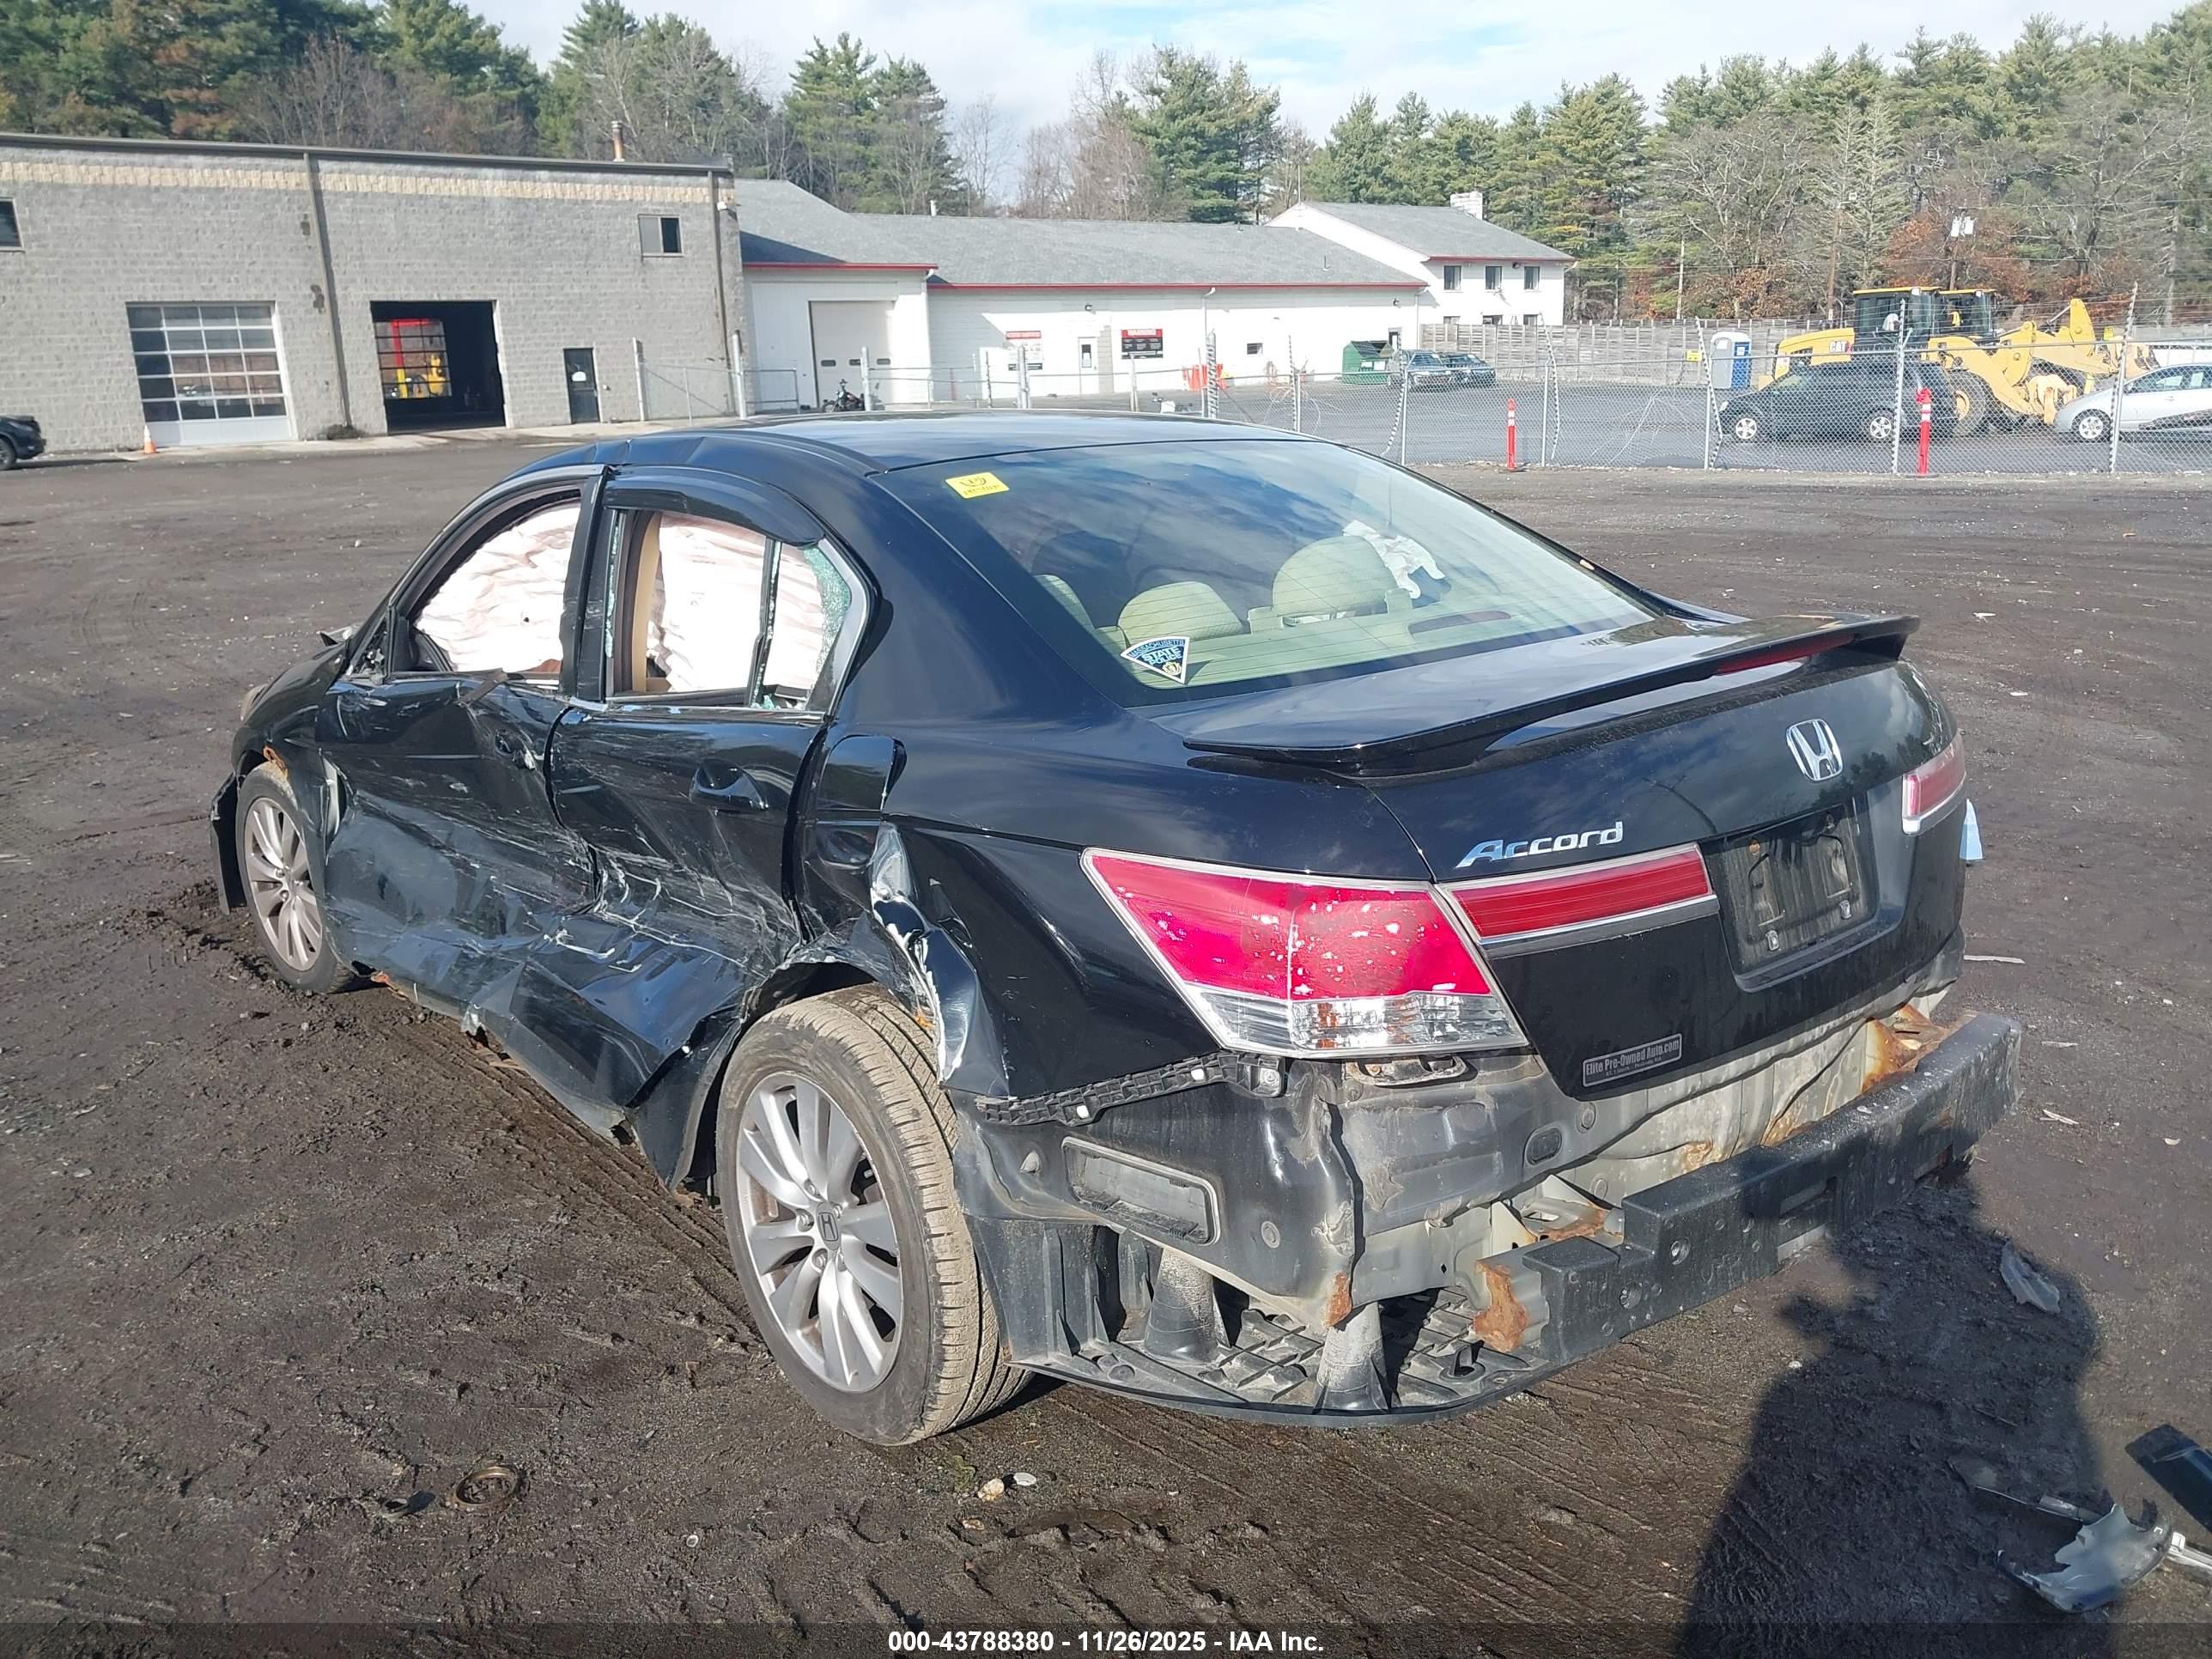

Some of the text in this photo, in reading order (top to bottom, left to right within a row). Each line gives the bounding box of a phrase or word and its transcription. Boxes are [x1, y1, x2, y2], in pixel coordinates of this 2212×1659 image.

[1141, 646, 1181, 661] STATE
[1148, 653, 1182, 665] POLICE
[1455, 821, 1624, 869] Accord
[1586, 1040, 1680, 1076] Elite Pre-Owned Auto.com
